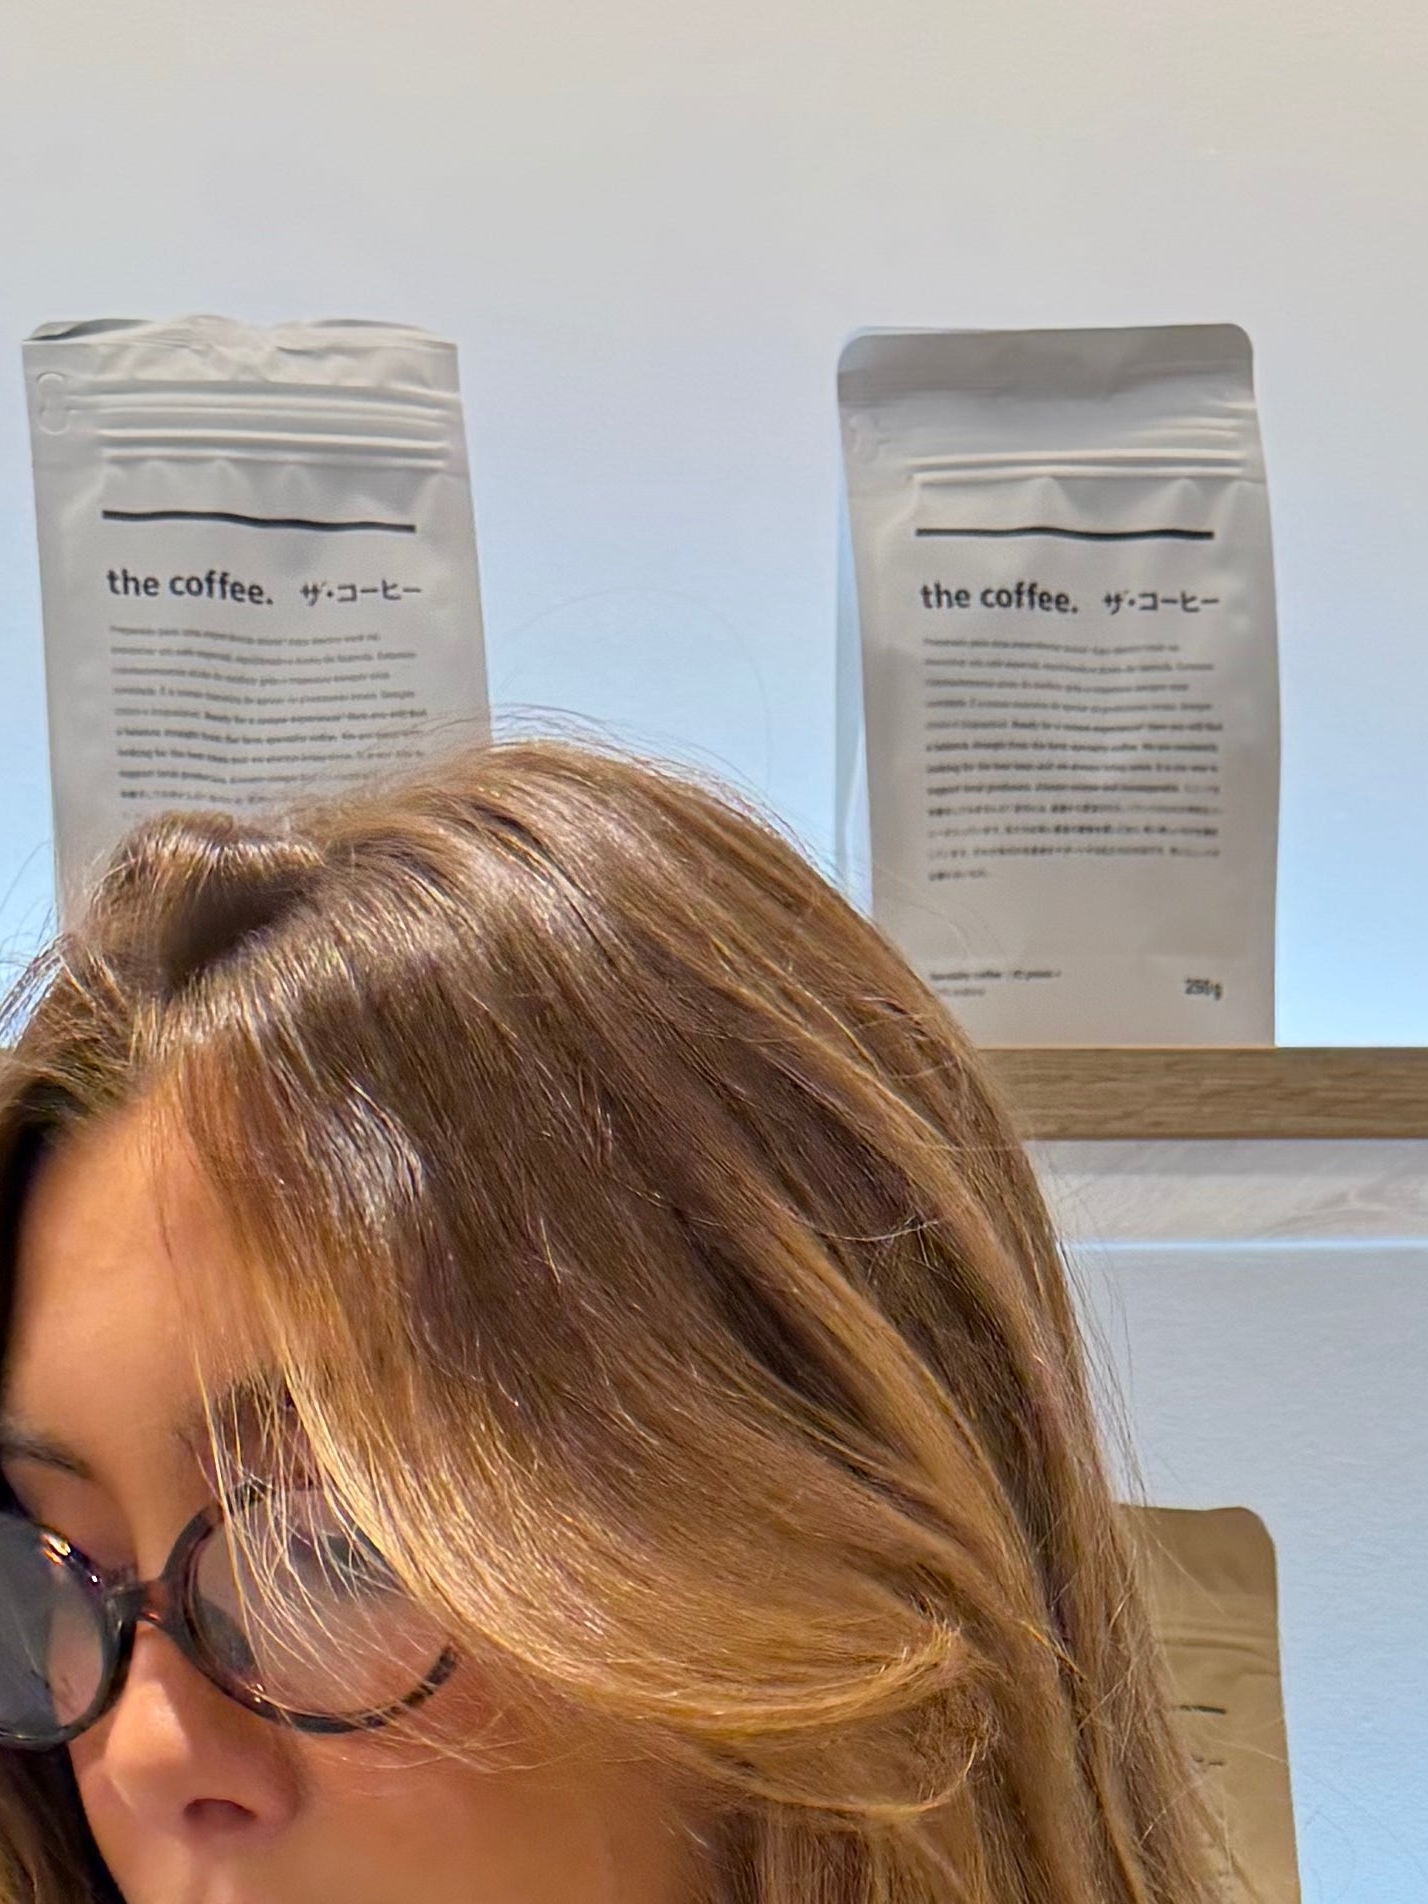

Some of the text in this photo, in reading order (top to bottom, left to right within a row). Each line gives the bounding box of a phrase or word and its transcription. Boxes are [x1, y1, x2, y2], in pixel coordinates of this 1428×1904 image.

[106, 568, 274, 606] the coffee.
[920, 580, 1079, 614] the coffee.
